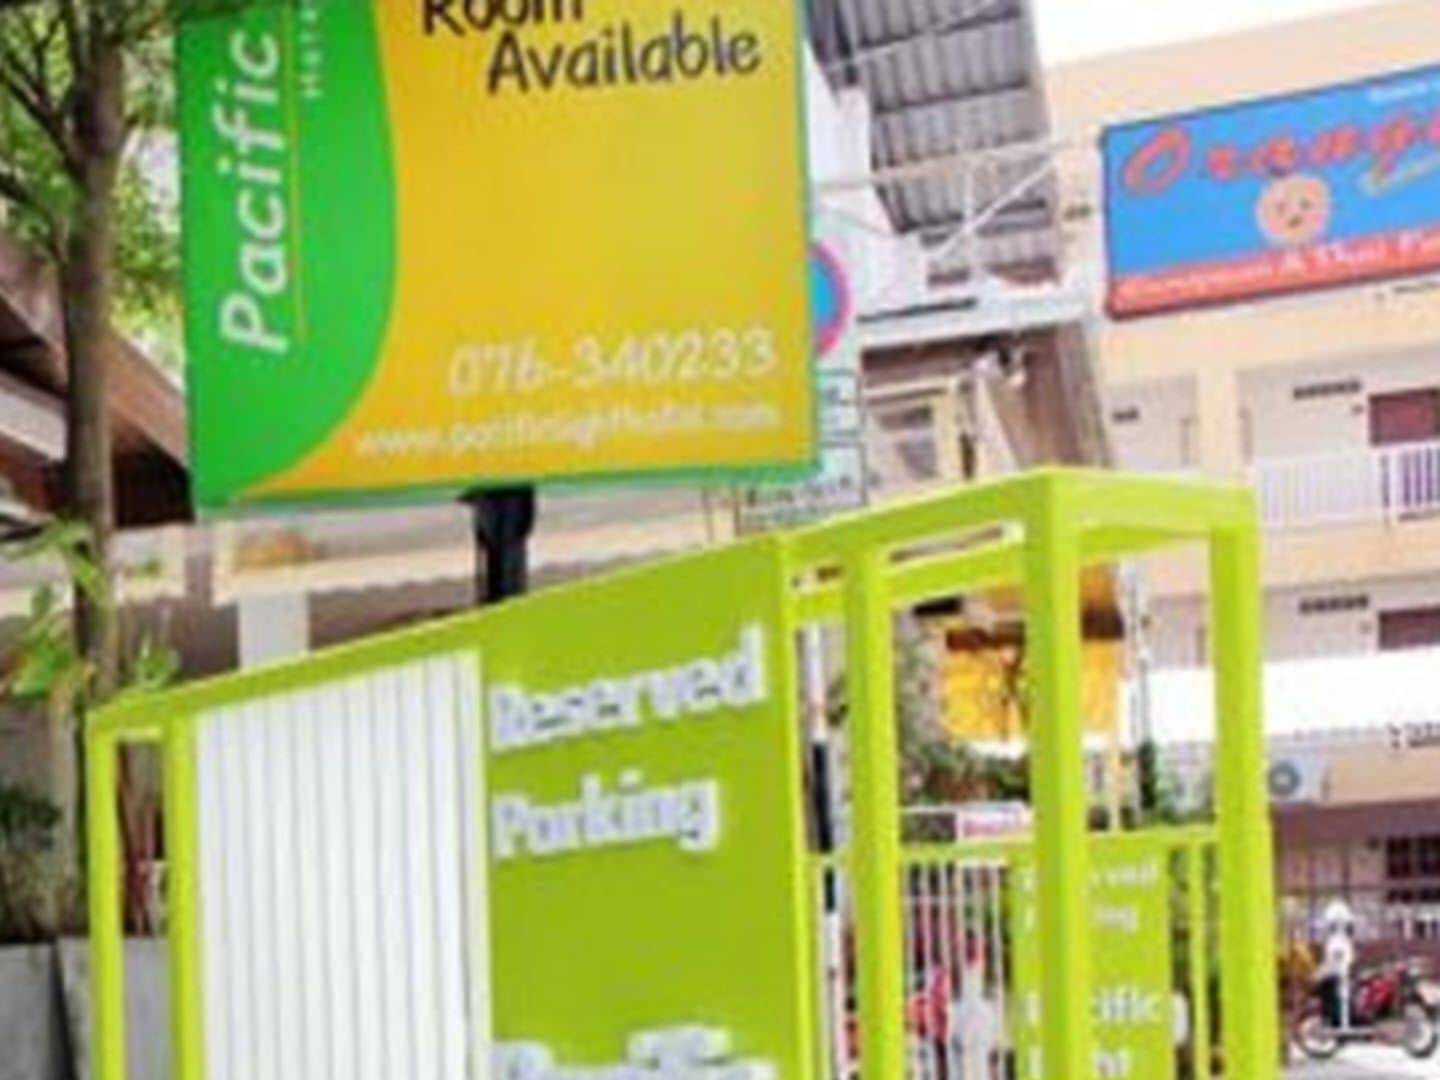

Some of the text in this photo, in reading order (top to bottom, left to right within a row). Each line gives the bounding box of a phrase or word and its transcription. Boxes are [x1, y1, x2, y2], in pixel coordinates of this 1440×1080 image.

[485, 8, 763, 96] Available
[212, 28, 290, 356] Pacific
[446, 325, 778, 396] 076-340233
[491, 626, 767, 752] Reserved
[492, 769, 719, 860] Parking
